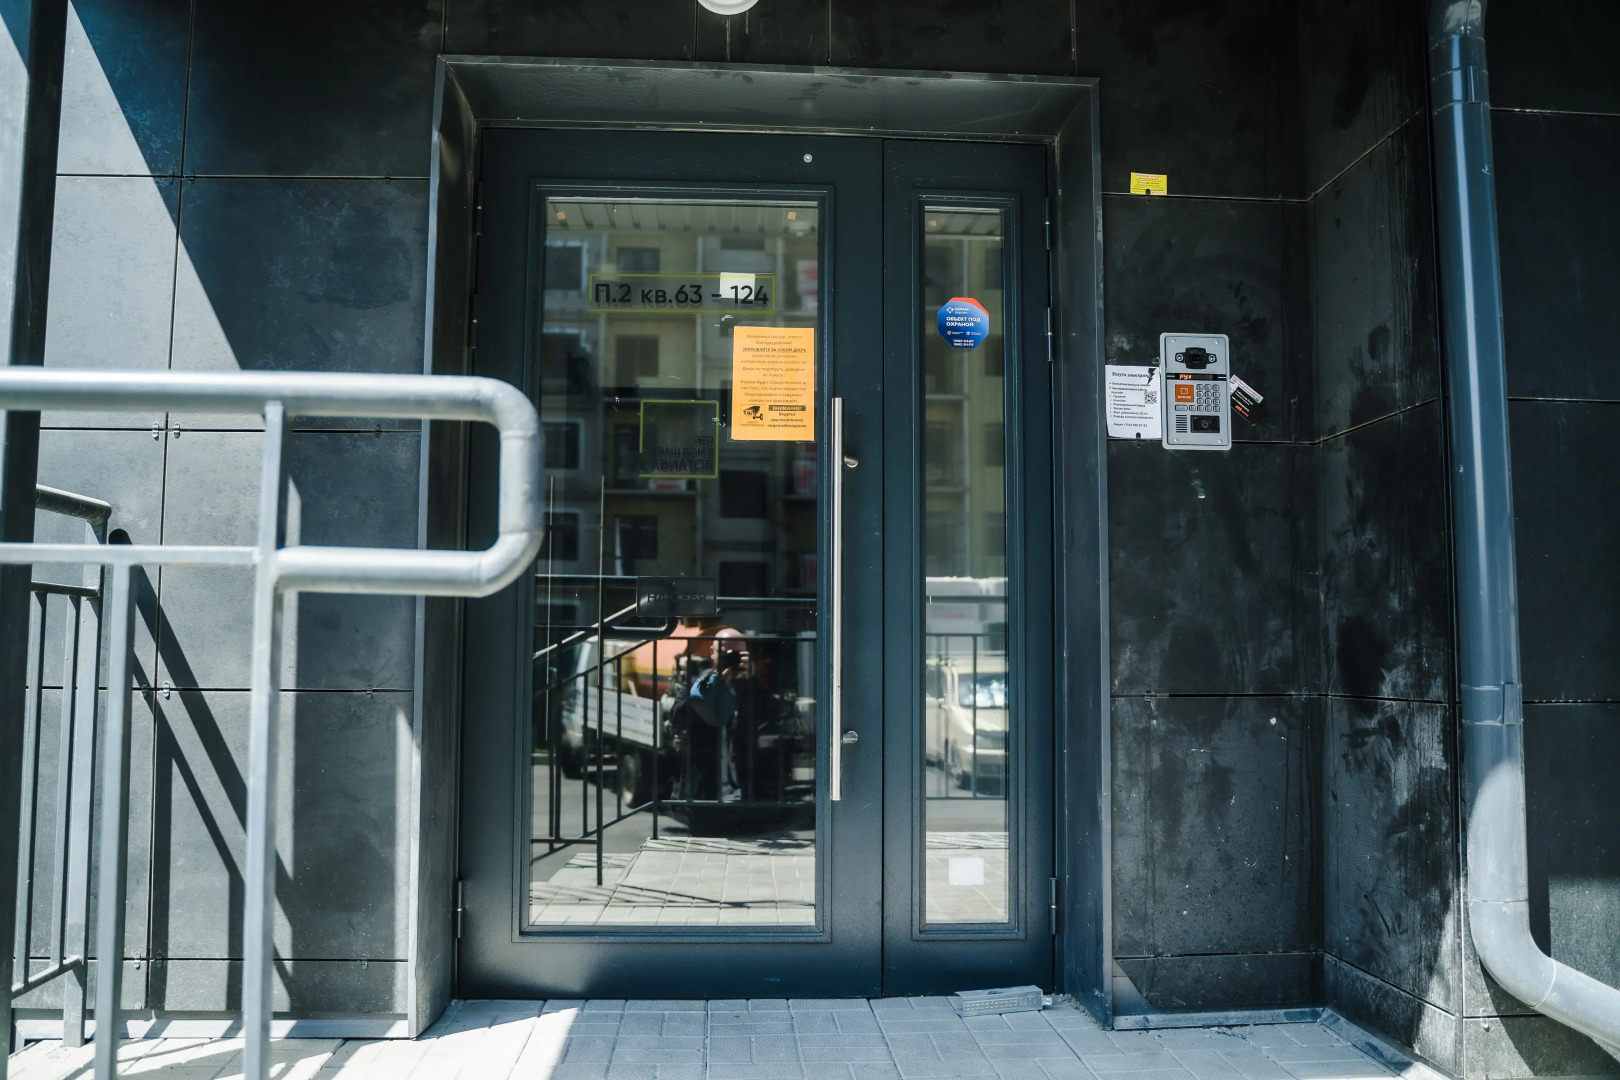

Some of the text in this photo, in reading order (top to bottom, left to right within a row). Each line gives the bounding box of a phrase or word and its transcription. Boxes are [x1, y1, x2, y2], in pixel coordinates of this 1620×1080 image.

[595, 283, 632, 303] П.2
[641, 284, 703, 304] кв.63
[730, 285, 769, 304] 124
